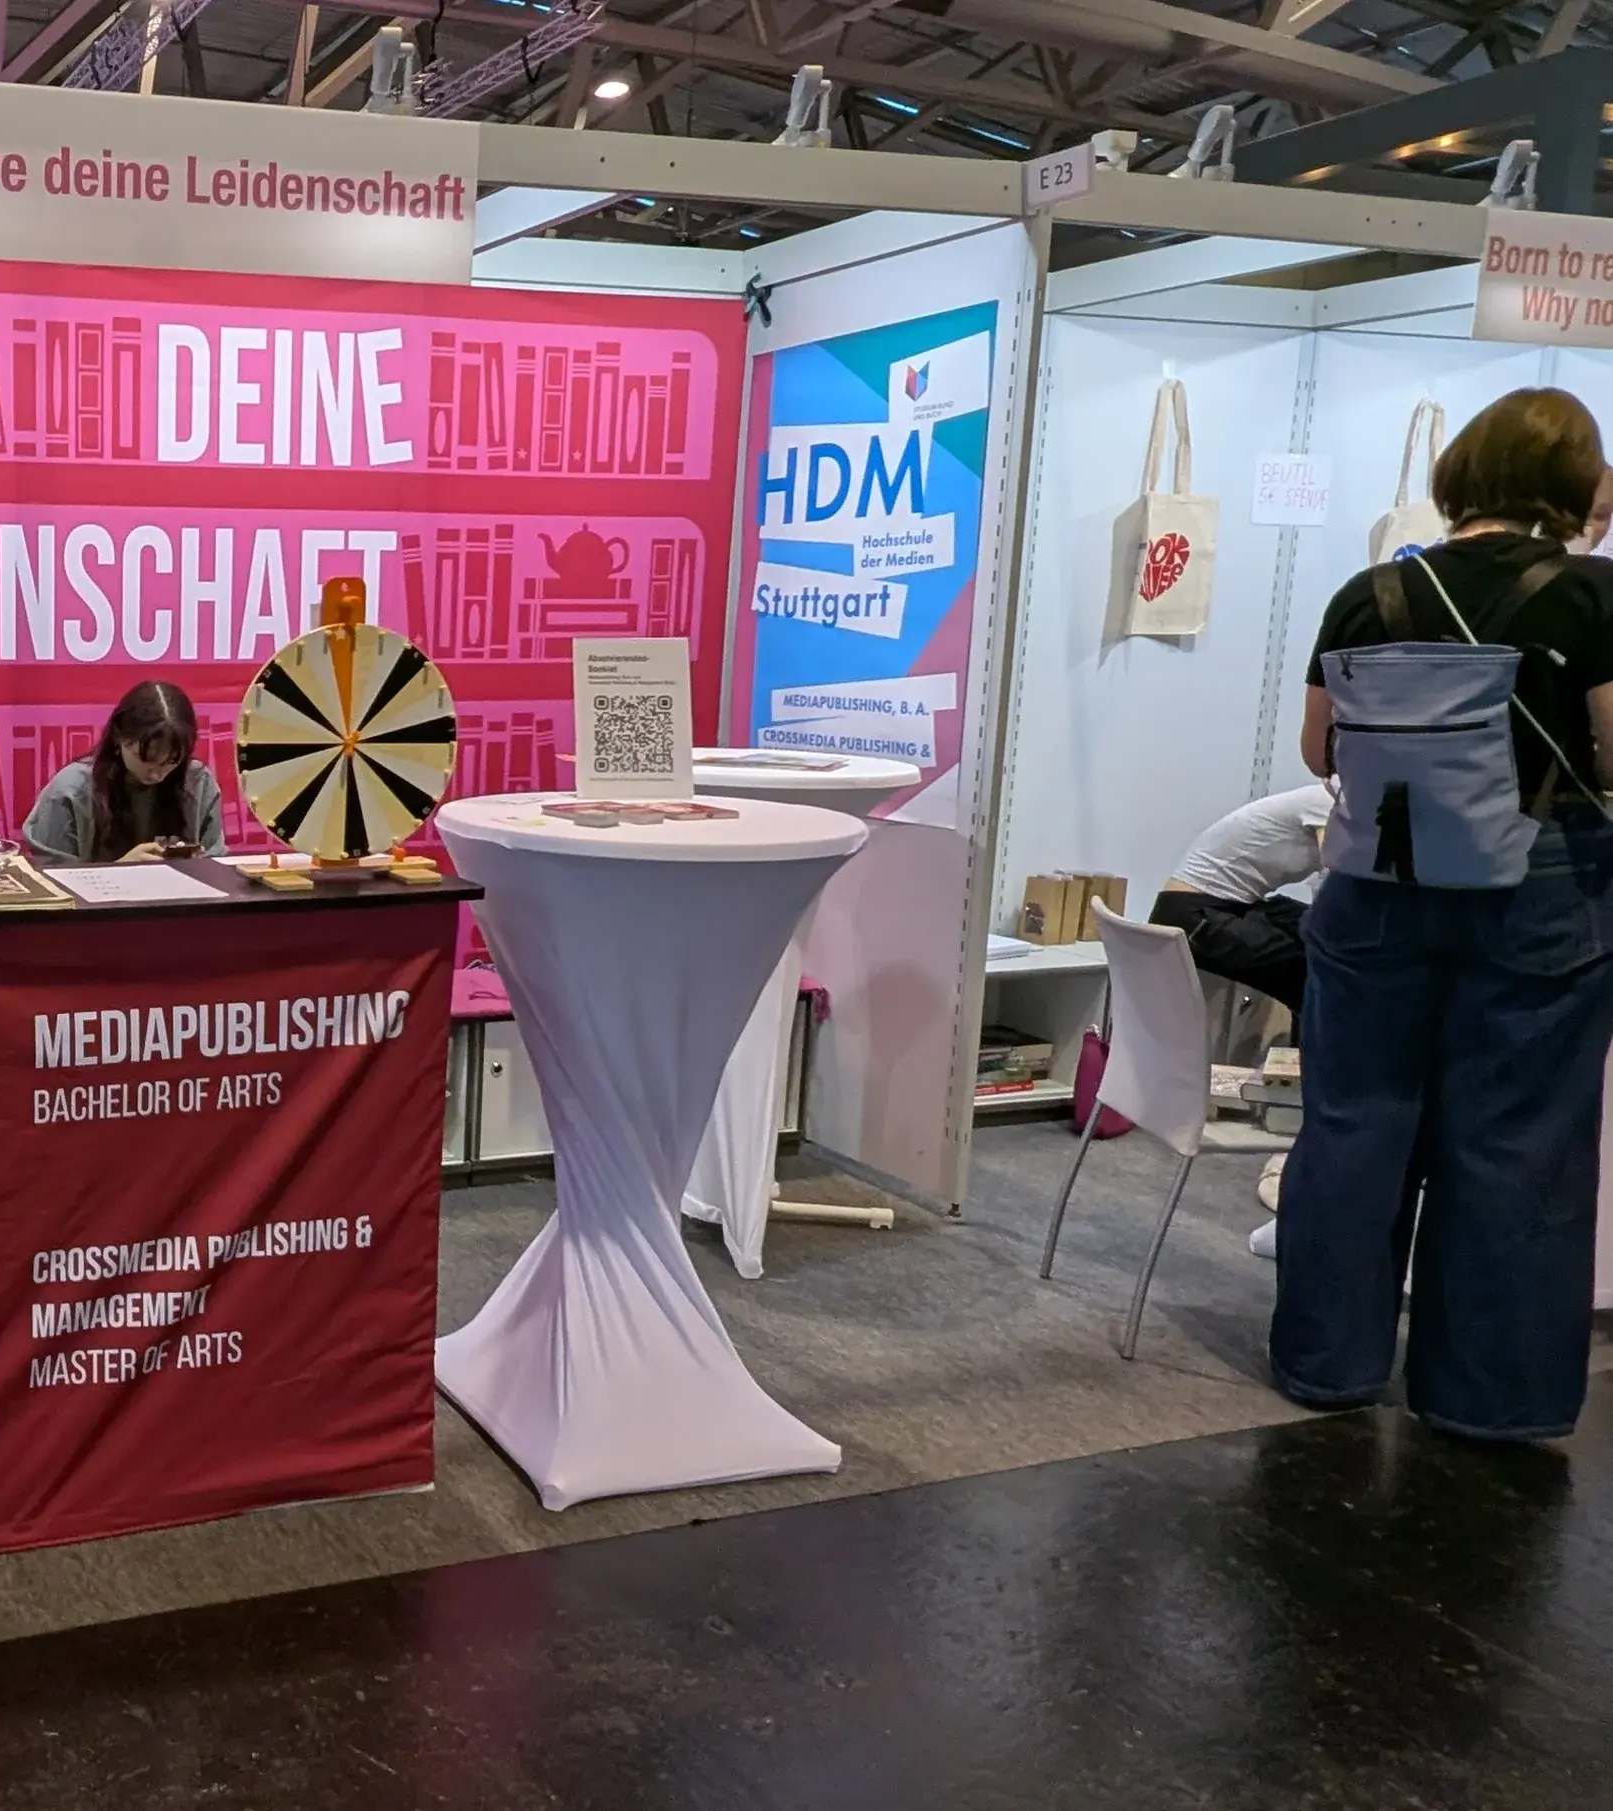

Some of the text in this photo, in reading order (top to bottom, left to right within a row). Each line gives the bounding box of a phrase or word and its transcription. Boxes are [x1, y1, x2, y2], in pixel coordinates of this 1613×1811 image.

[44, 146, 169, 202] deine
[186, 155, 466, 222] Leidenschaft
[1040, 162, 1073, 190] E 23
[1485, 235, 1549, 276] Born
[1558, 241, 1583, 279] to
[1522, 285, 1579, 332] Why
[157, 322, 414, 467] DEINE
[757, 429, 925, 527] HDM
[1261, 462, 1317, 485] BEUTEL
[861, 551, 935, 568] der Medien
[862, 530, 934, 549] Hochschule
[755, 584, 891, 627] Stuttgart
[783, 694, 930, 716] MEDIAPUBLISHING, B. A.
[763, 729, 931, 758] CROSSMEDIA PUBLISHING &
[33, 1072, 283, 1124] BACHELOR OF ARTS
[33, 1215, 373, 1284] CROSSMEDIA PUBLISHING &
[32, 1284, 211, 1339] MANAGEMENT
[29, 1331, 243, 1389] MASTER OF ARTS
